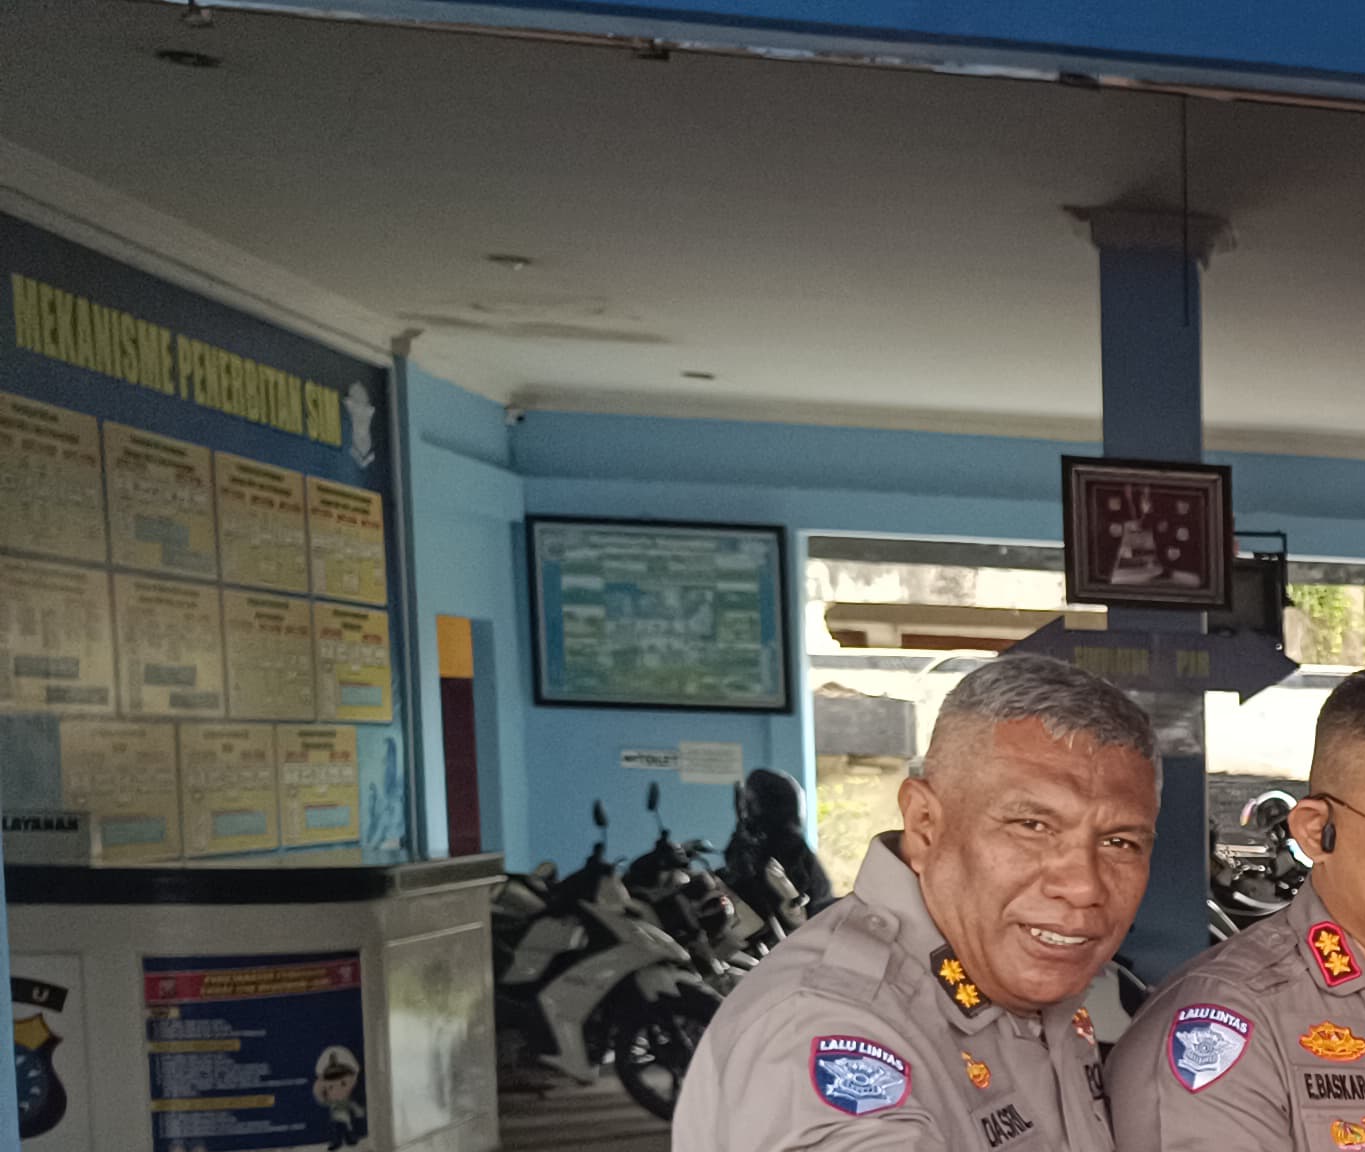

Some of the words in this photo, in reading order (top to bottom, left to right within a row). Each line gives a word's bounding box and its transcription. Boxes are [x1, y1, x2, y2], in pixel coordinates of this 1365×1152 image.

[12, 272, 174, 396] MEKANISME
[305, 380, 342, 447] SIM
[1178, 1007, 1209, 1021] LALU
[1209, 1010, 1249, 1034] LINTAS
[819, 1039, 857, 1052] LALU
[859, 1042, 904, 1071] LINTAS
[981, 1103, 1035, 1149] DASRIL
